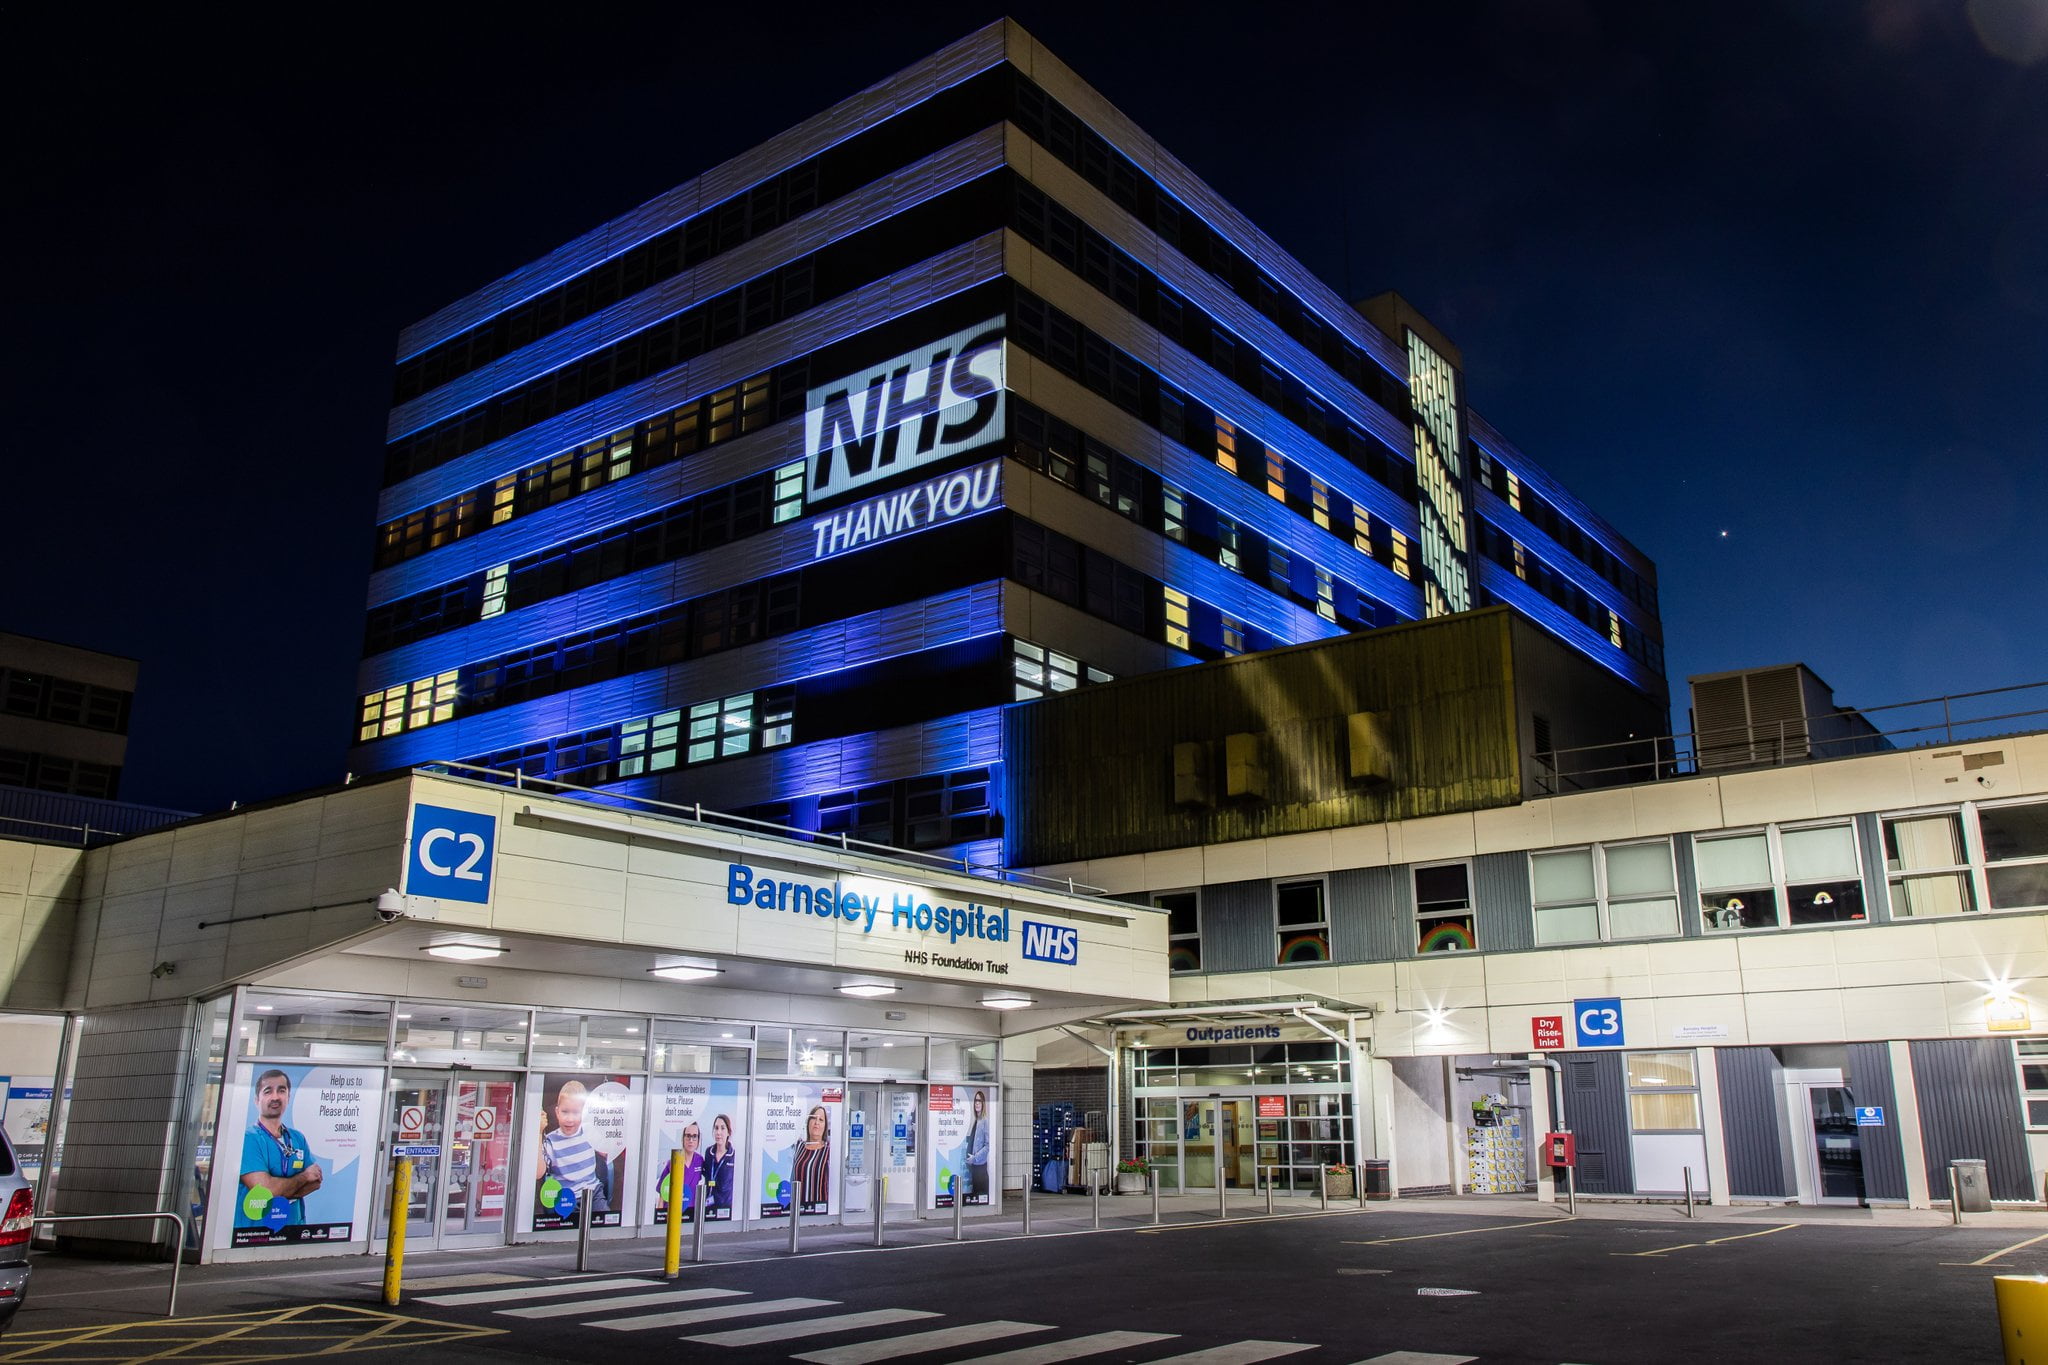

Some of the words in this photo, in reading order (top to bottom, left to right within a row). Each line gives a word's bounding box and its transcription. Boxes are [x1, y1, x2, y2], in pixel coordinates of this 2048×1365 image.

[813, 326, 1006, 491] NHS
[813, 487, 921, 558] THANK
[926, 463, 999, 523] YOU
[419, 828, 485, 881] C2
[728, 864, 880, 934] Barnsley
[892, 892, 1010, 944] Hospital
[1025, 924, 1077, 962] NHS
[904, 950, 928, 964] NHS
[932, 953, 984, 972] Foundation
[986, 960, 1009, 974] Trust
[1539, 1019, 1555, 1029] Dry
[1580, 1008, 1619, 1035] C3
[1186, 1024, 1280, 1043] Outpatients
[1539, 1038, 1559, 1046] Inlet
[330, 1074, 345, 1088] Help
[346, 1078, 354, 1086] us
[355, 1076, 363, 1086] to
[667, 1083, 674, 1093] We
[674, 1084, 690, 1093] deliver
[690, 1084, 705, 1094] babies
[321, 1090, 336, 1103] help
[678, 1095, 694, 1104] Please
[770, 1091, 783, 1103] have
[783, 1092, 795, 1105] lung
[319, 1105, 341, 1116] Please
[343, 1105, 360, 1116] don't
[665, 1107, 677, 1116] don't
[677, 1107, 693, 1116] smoke.
[767, 1107, 784, 1117] cancer.
[785, 1105, 801, 1117] Please
[334, 1121, 358, 1132] smoke.
[593, 1116, 610, 1126] Please
[611, 1116, 624, 1126] don't
[766, 1120, 779, 1130] don't
[779, 1120, 796, 1130] smoke.
[605, 1128, 623, 1138] smoke.
